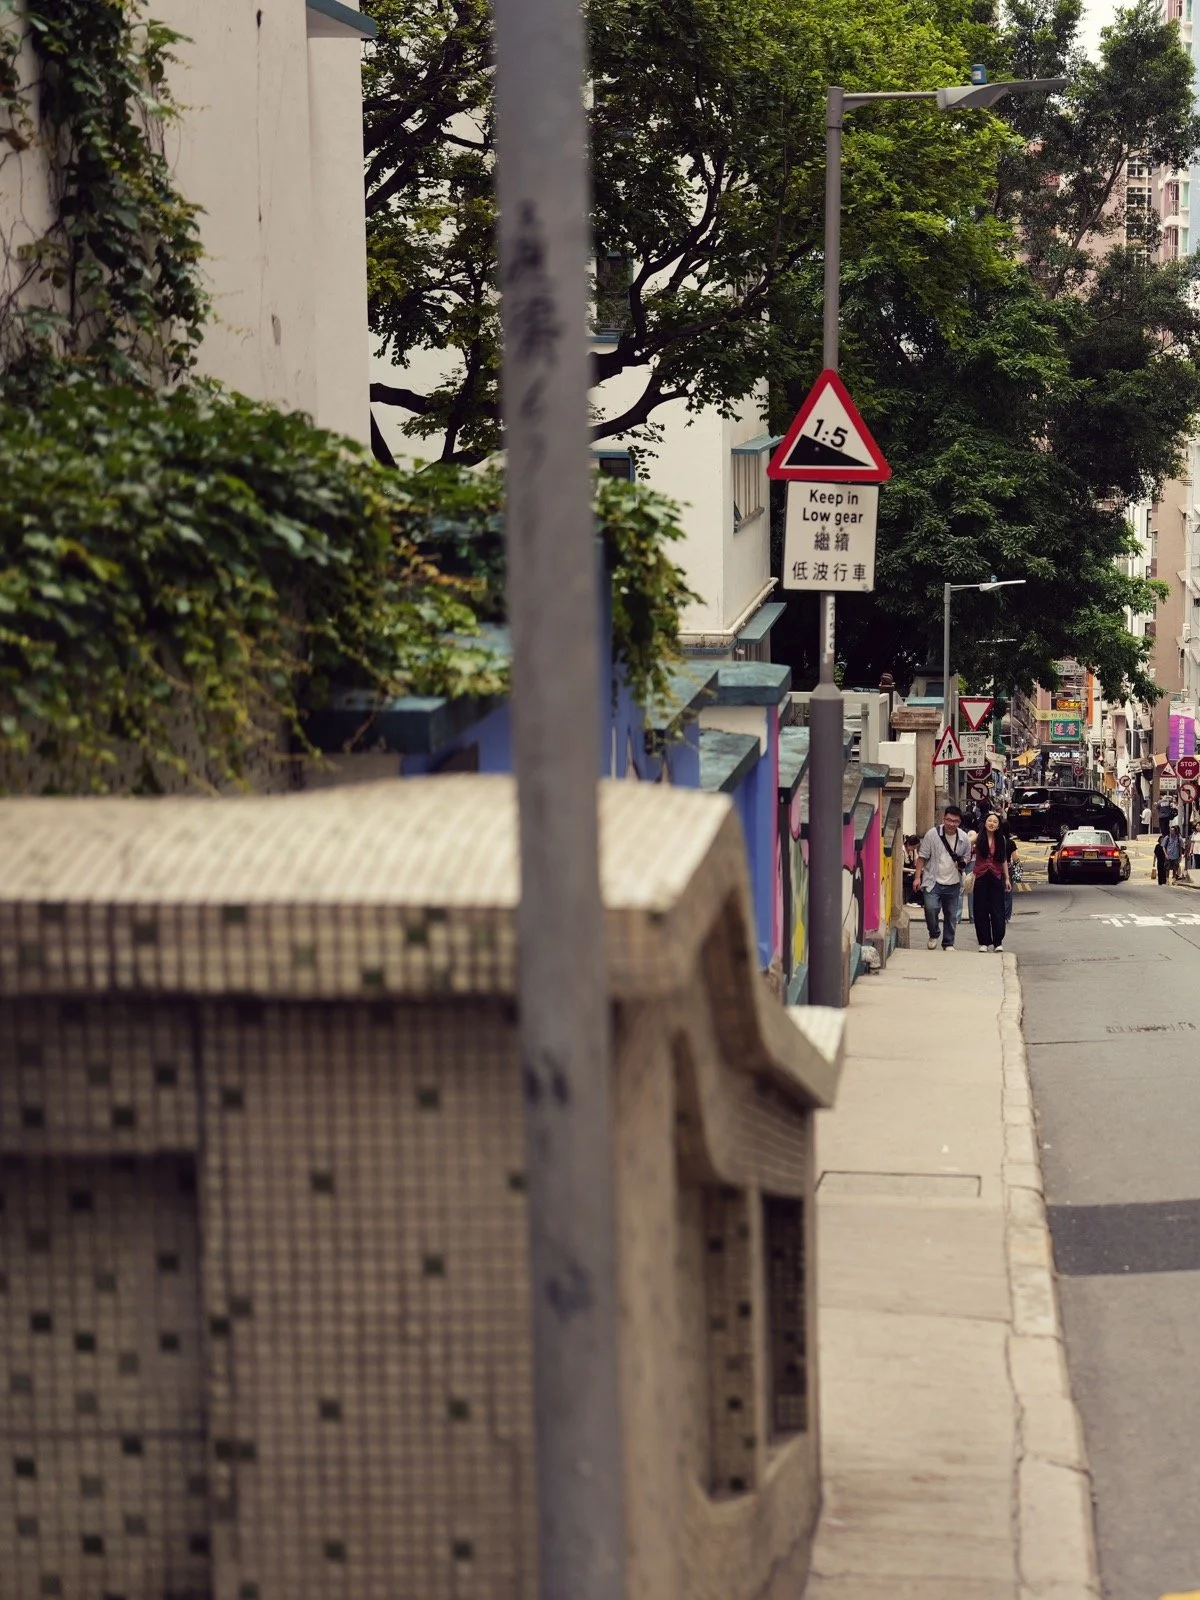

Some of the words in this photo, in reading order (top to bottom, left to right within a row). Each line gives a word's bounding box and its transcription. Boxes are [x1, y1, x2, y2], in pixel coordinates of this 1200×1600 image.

[814, 418, 848, 449] 1:5
[809, 489, 843, 506] Keep
[847, 490, 859, 505] in
[802, 508, 831, 522] Low
[834, 511, 864, 526] gear
[814, 532, 850, 552] 繼續
[792, 560, 867, 582] 低波行車
